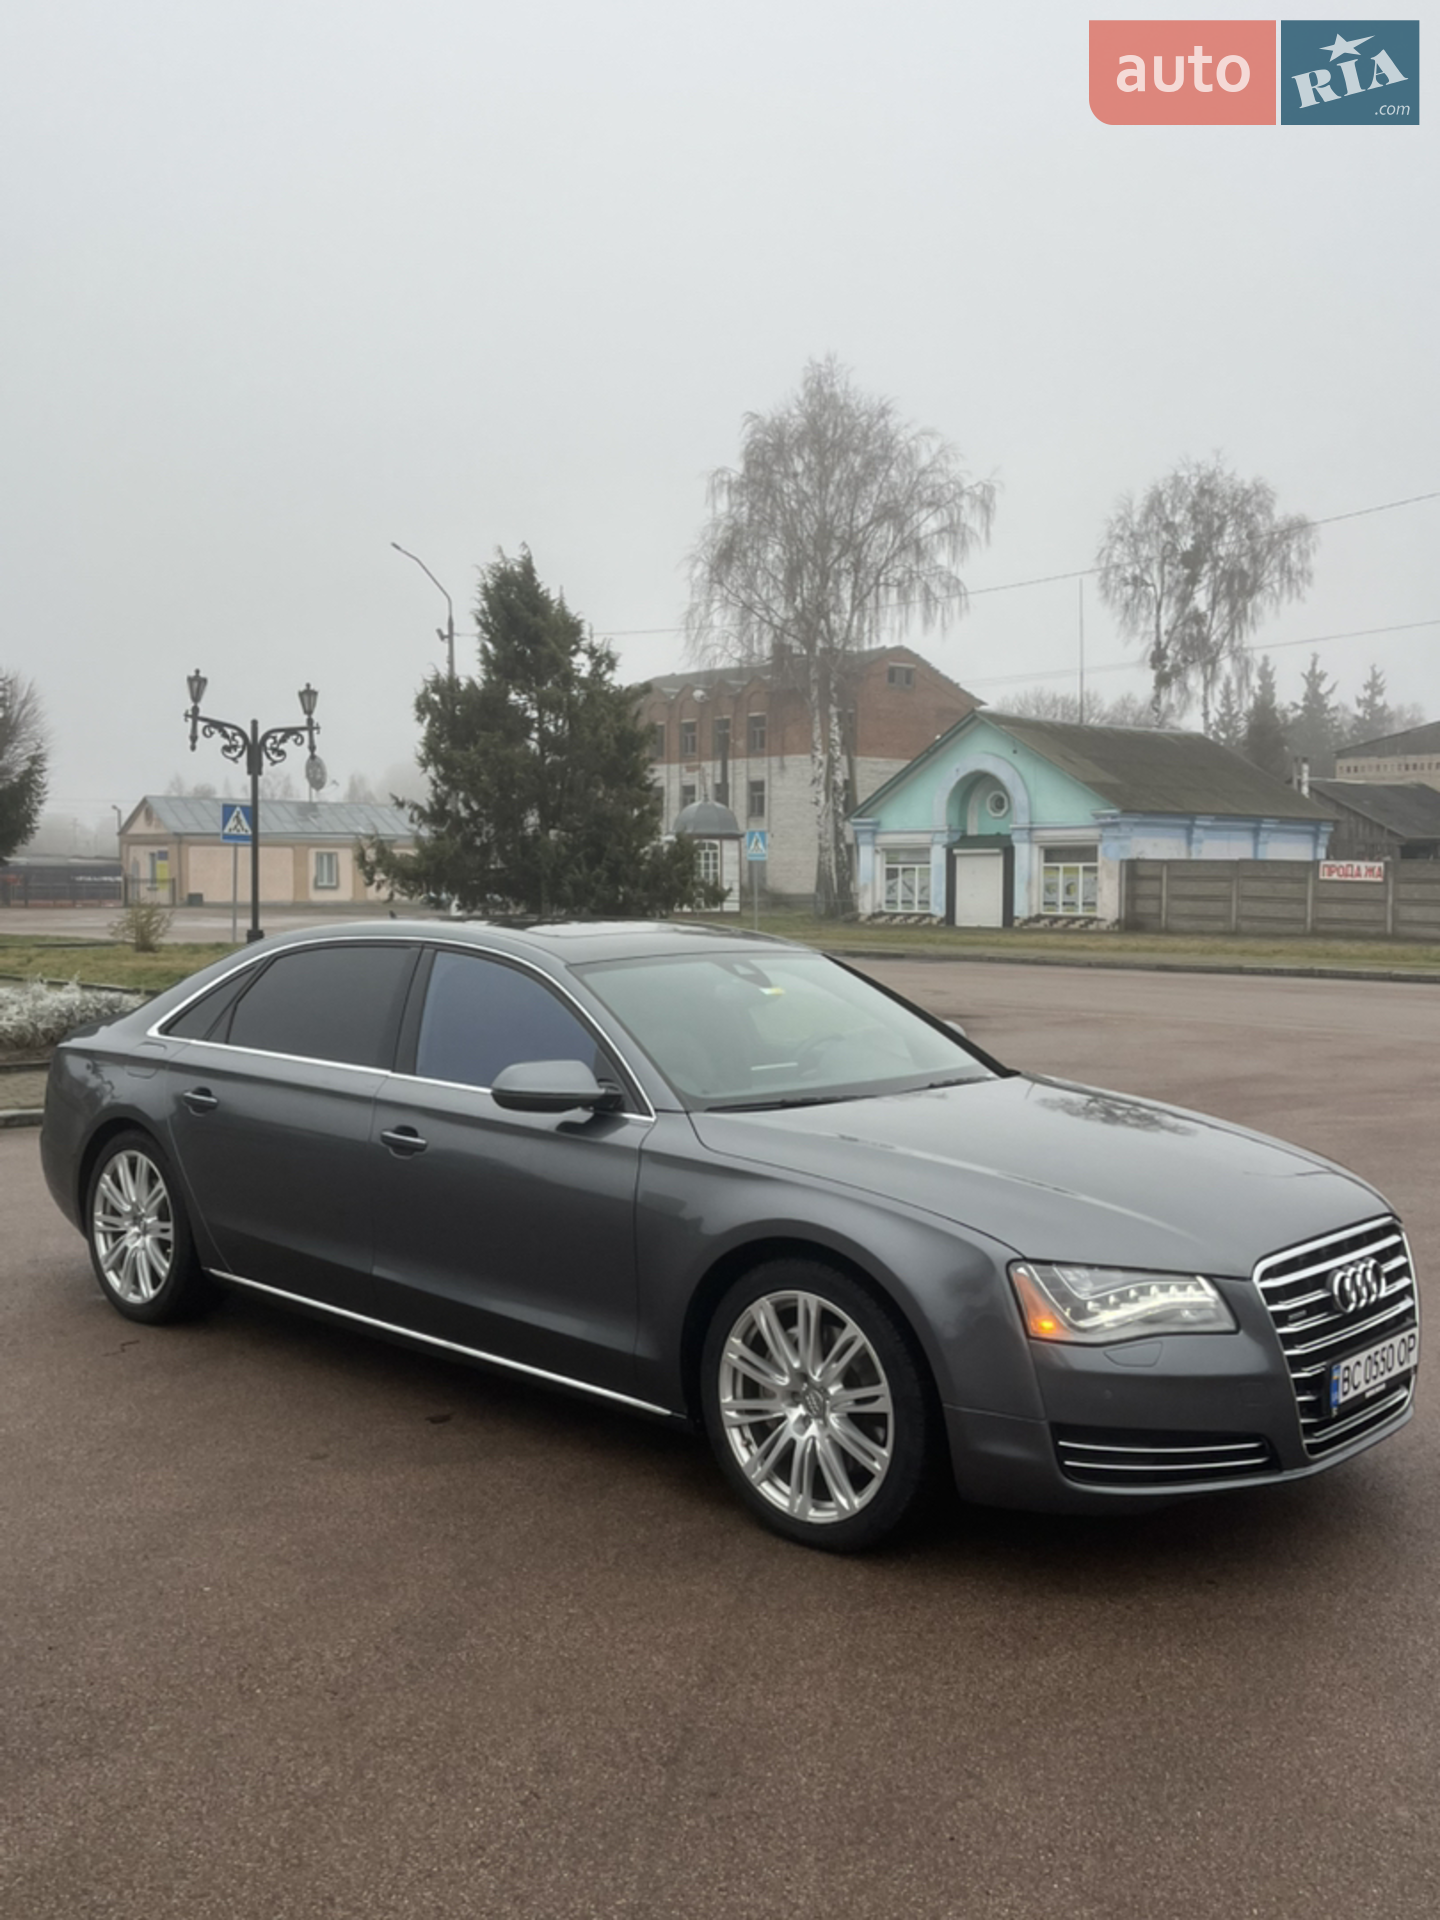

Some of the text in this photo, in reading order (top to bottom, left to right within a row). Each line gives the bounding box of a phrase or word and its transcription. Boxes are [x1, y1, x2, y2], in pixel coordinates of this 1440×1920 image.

[1341, 1360, 1361, 1397] BC
[1364, 1343, 1395, 1385] 0550
[1398, 1332, 1416, 1367] OP
